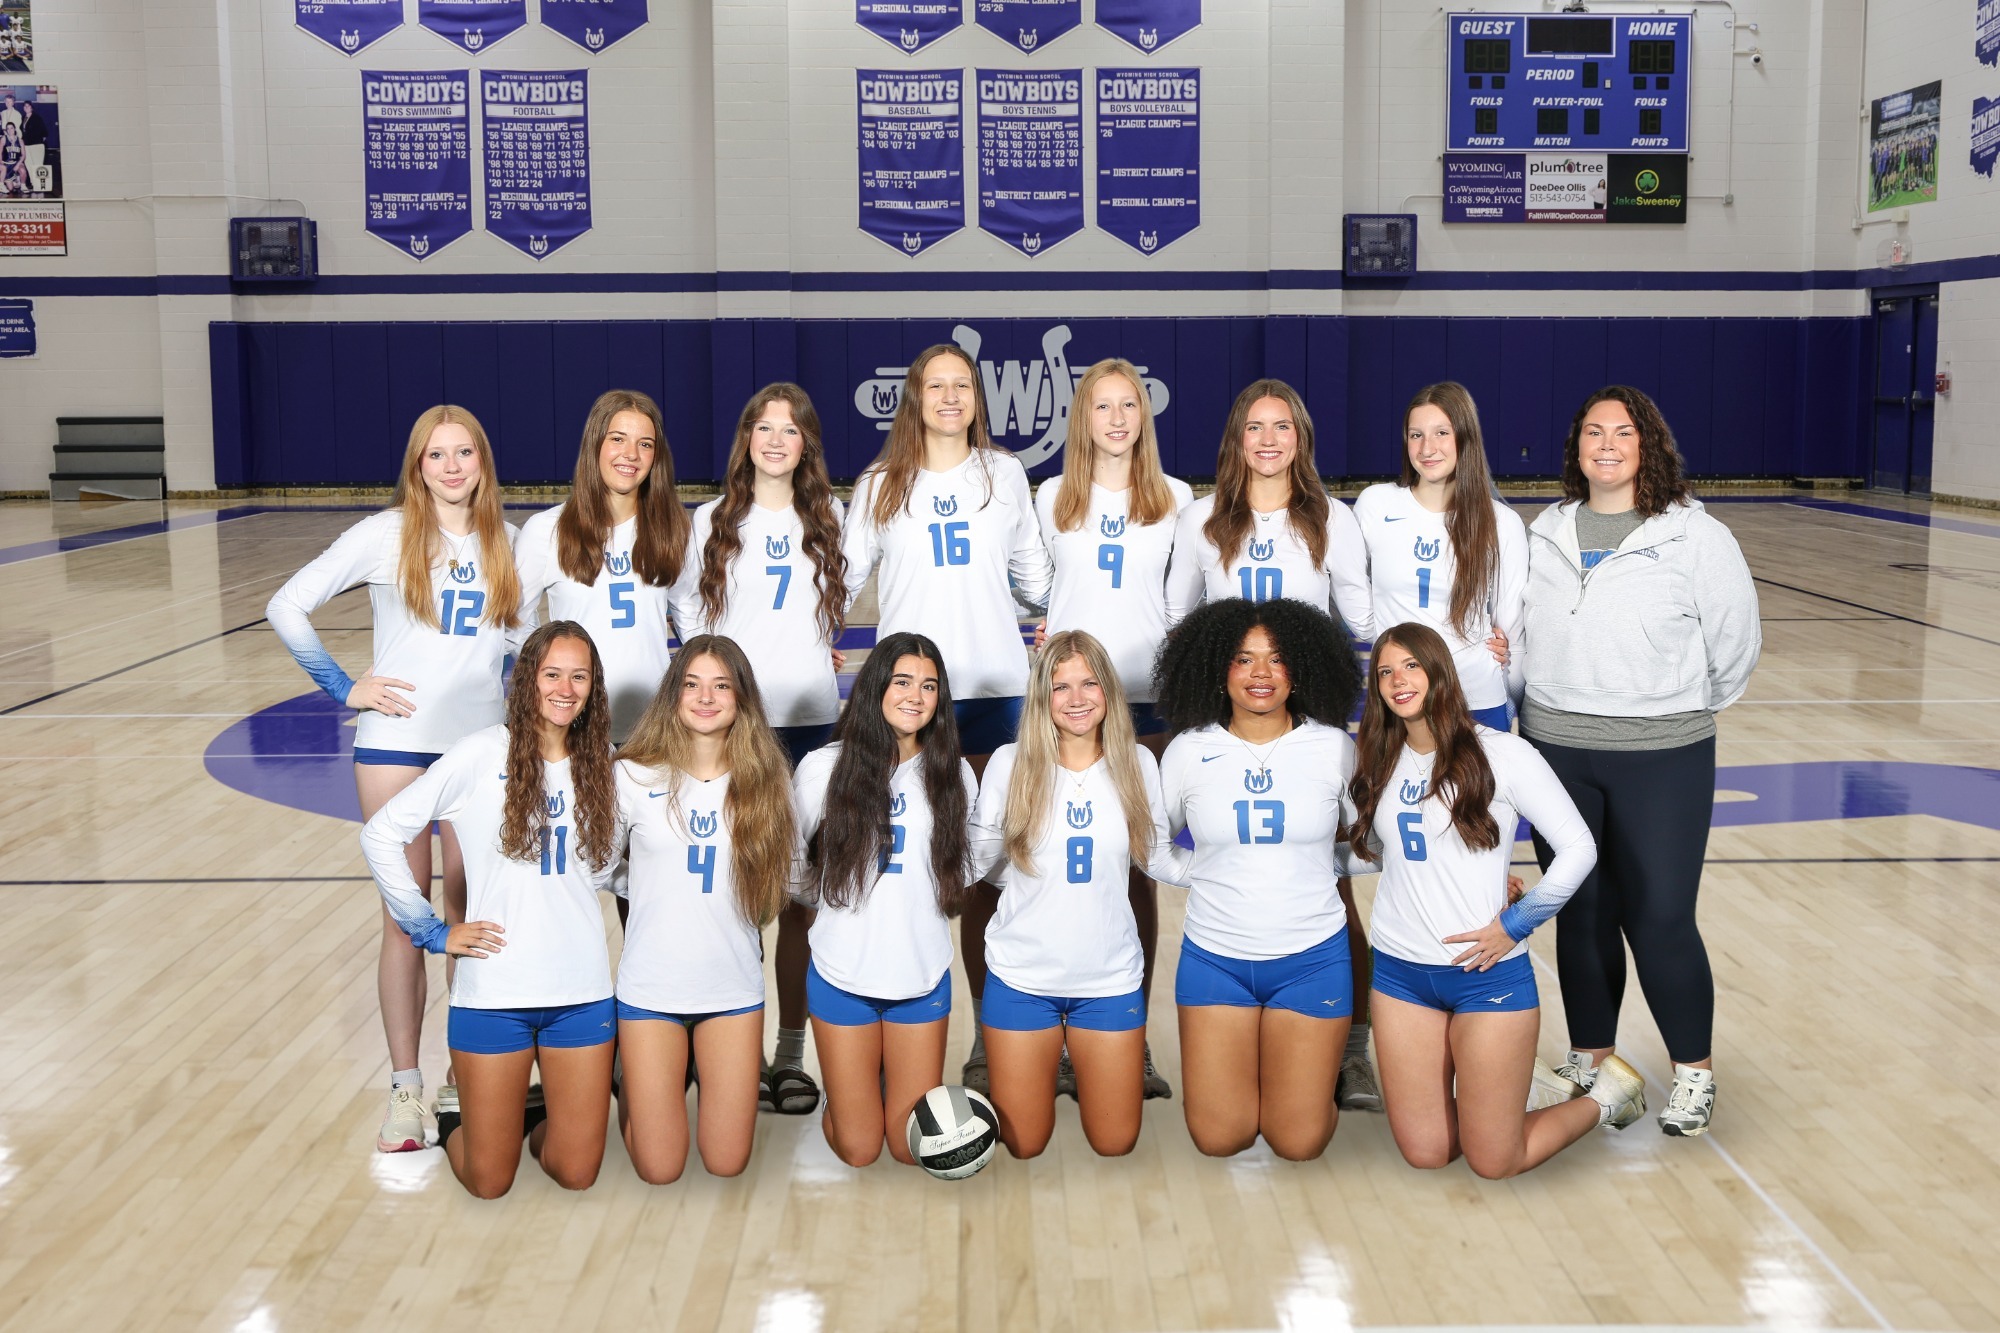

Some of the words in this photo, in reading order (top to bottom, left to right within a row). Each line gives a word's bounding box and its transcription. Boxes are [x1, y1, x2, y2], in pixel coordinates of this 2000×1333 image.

[872, 4, 911, 13] REGIONAL
[913, 5, 946, 13] CHAMPS
[1460, 21, 1515, 35] GUEST
[1628, 22, 1678, 36] HOME
[1526, 69, 1574, 80] PERIOD
[366, 81, 465, 103] COWBOYS
[485, 81, 583, 102] COWBOYS
[861, 80, 959, 102] COWBOYS
[981, 80, 1078, 101] COWBOYS
[1100, 79, 1197, 99] COWBOYS
[1470, 97, 1503, 106] FOULS
[1533, 98, 1604, 106] PLAYER-FOUL
[1634, 98, 1667, 106] FOULS
[381, 108, 403, 116] BOYS
[406, 107, 452, 116] SWIMMING
[513, 107, 555, 115] FOOTBALL
[1003, 106, 1024, 114] BOYS
[1027, 106, 1056, 114] TENNIS
[1110, 104, 1131, 112] BOYS
[1134, 104, 1185, 112] VOLLEYBALL
[384, 123, 415, 132] LEAGUE
[417, 123, 450, 131] CHAMPS
[502, 123, 533, 131] LEAGUE
[535, 123, 568, 131] CHAMPS
[878, 122, 907, 131] LEAGUE
[910, 122, 943, 130] CHAMPS
[997, 122, 1027, 130] LEAGUE
[1030, 122, 1063, 130] CHAMPS
[1116, 120, 1146, 128] LEAGUE
[1148, 120, 1181, 128] CHAMPS
[1467, 137, 1505, 146] POINTS
[1534, 138, 1571, 146] MATCH
[1631, 138, 1669, 146] POINTS
[1113, 168, 1149, 176] DISTRICT
[1151, 168, 1184, 176] CHAMPS
[1448, 163, 1503, 172] WYOMING
[875, 170, 911, 179] DISTRICT
[914, 170, 947, 179] CHAMPS
[1449, 186, 1522, 194] GoWyomingAir.com
[383, 193, 419, 202] DISTRICT
[421, 193, 454, 201] CHAMPS
[501, 192, 539, 201] REGIONAL
[542, 192, 574, 201] CHAMPS
[995, 191, 1031, 199] DISTRICT
[1034, 191, 1066, 199] CHAMPS
[1530, 194, 1586, 202] 513-543-0754
[875, 200, 913, 209] REGIONAL
[915, 200, 948, 209] CHAMPS
[1112, 198, 1150, 206] REGIONAL
[1152, 198, 1184, 206] CHAMPS
[928, 521, 970, 567] 16
[1098, 544, 1124, 589] 9
[765, 565, 792, 610] 7
[1415, 568, 1431, 609] 1
[608, 582, 636, 629] 5
[440, 589, 486, 637] 12
[1233, 800, 1285, 845] 13
[1397, 812, 1427, 861] 6
[540, 826, 568, 875] 11
[878, 825, 906, 874] 2
[1066, 836, 1093, 884] 8
[687, 845, 717, 893] 4
[930, 1140, 951, 1150] Super
[934, 1139, 985, 1168] molten
